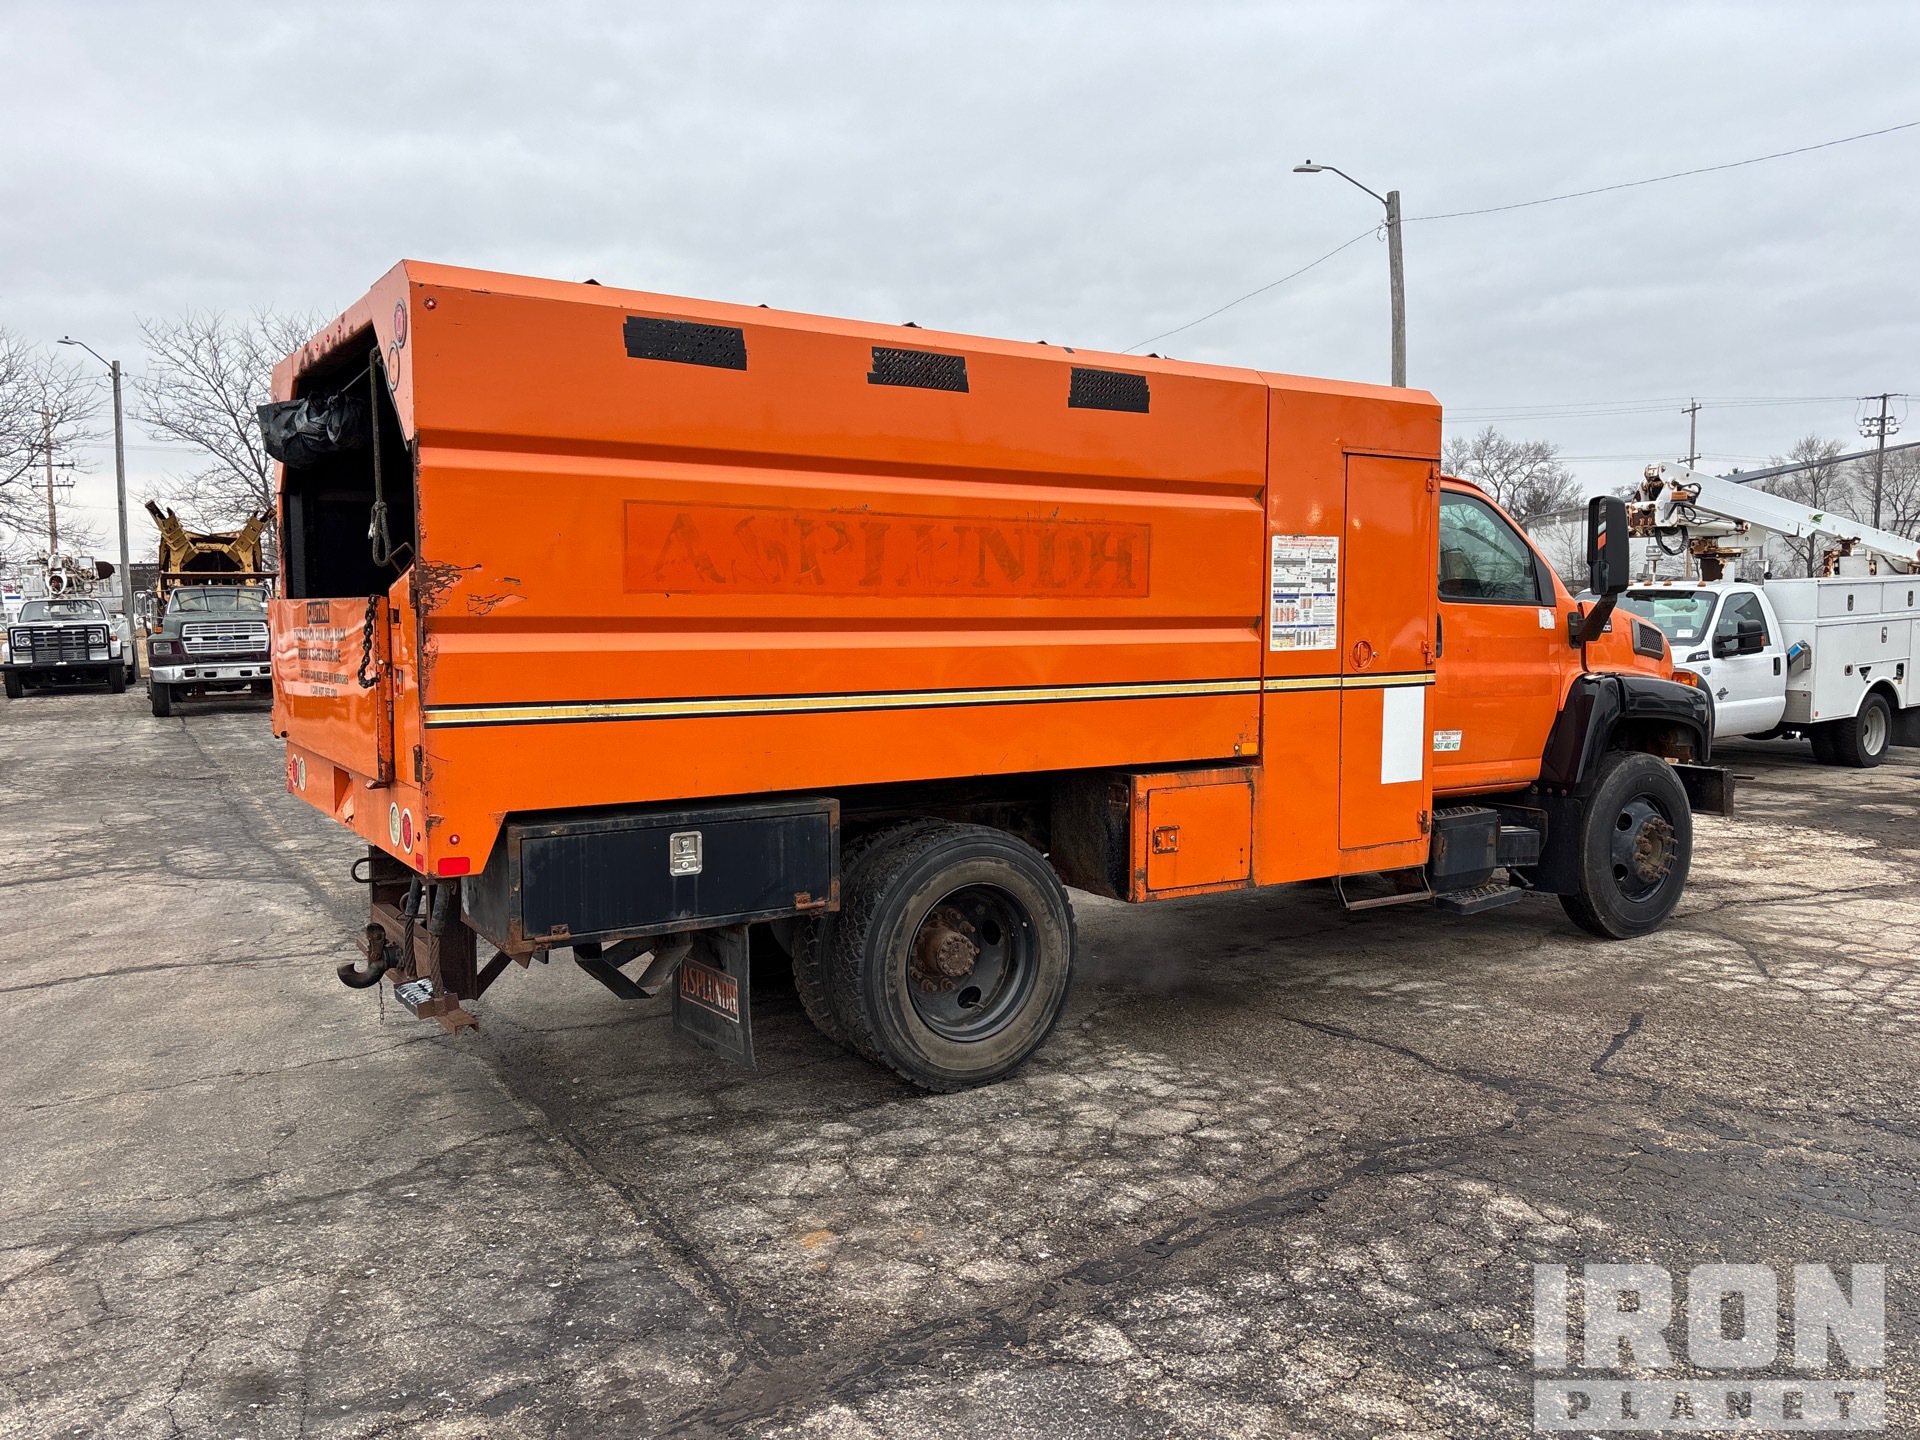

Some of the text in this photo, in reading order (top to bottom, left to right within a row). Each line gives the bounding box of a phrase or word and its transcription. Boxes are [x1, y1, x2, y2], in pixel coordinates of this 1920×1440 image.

[650, 512, 1138, 590] ASPLUNDH
[308, 604, 328, 621] CAUTION
[294, 628, 302, 641] THIS
[302, 628, 315, 641] TRUCK
[323, 628, 334, 642] ROLL
[334, 628, 346, 642] BACK
[311, 649, 321, 662] SAFE
[681, 964, 737, 1015] ASPLUNDH
